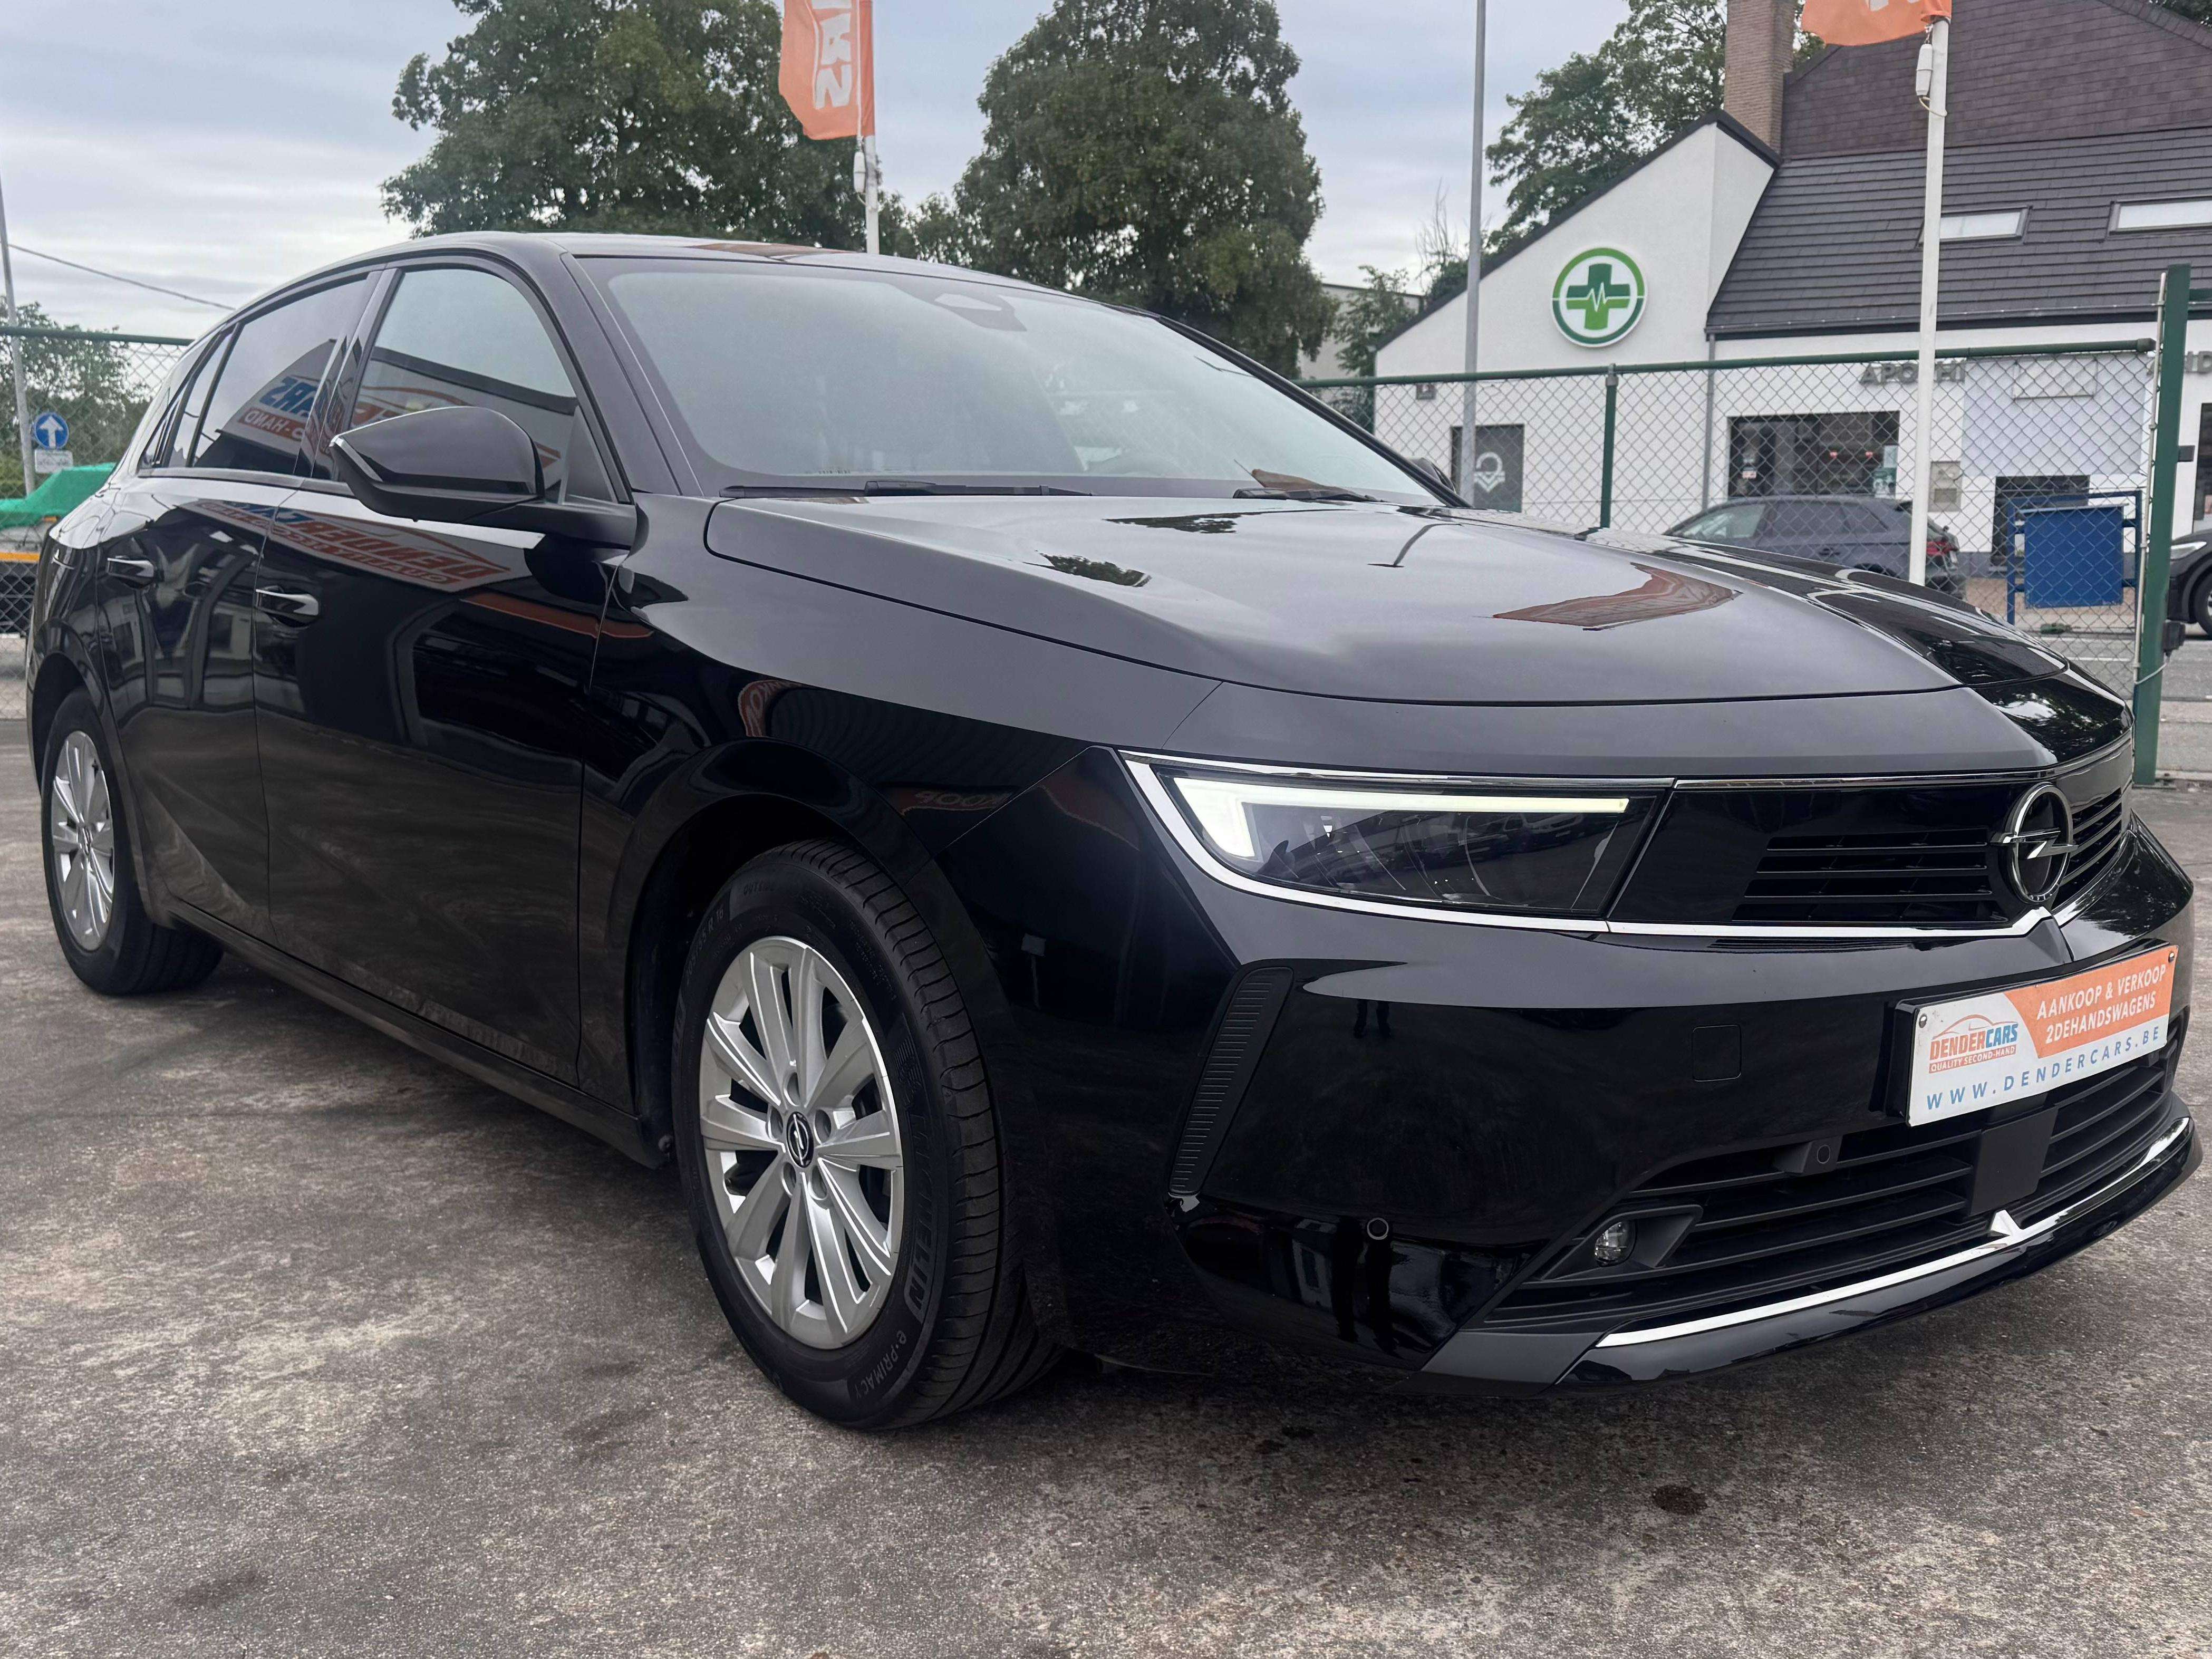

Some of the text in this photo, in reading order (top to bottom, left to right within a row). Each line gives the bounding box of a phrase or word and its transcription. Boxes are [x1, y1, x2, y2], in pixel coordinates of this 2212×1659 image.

[2036, 963, 2166, 1020] AANKOOP & VERKOOP
[2046, 991, 2156, 1044] 2DEHANDSWAGENS
[1929, 1023, 2018, 1061] DENDERCARS
[1930, 1046, 2015, 1073] QUALITY SECOND-HAND
